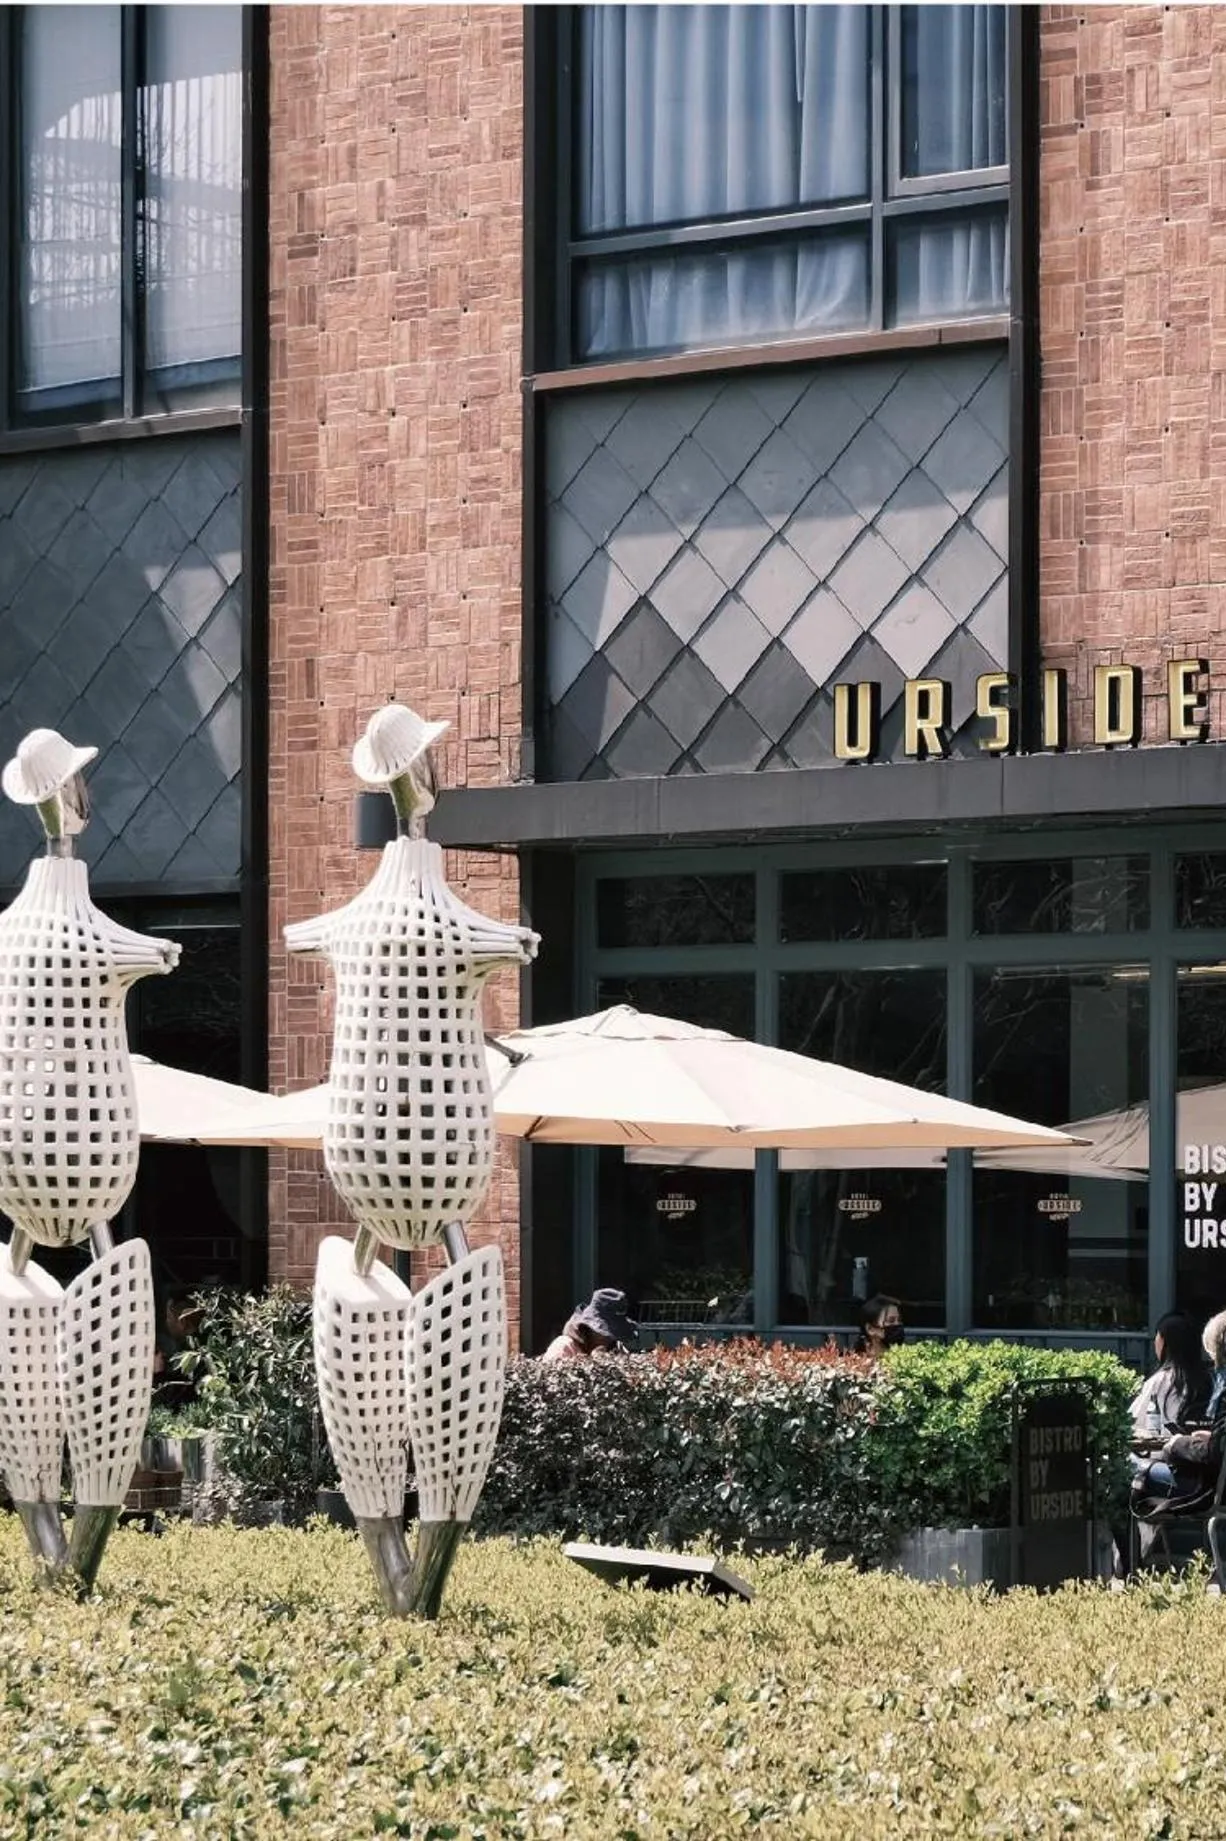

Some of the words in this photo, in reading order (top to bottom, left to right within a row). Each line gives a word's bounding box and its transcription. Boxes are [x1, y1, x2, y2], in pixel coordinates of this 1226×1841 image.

[834, 658, 1208, 761] URSIDE
[1184, 1182, 1217, 1213] BY
[1029, 1425, 1082, 1455] BISTRO
[1029, 1459, 1049, 1489] BY
[1030, 1490, 1083, 1520] URSIDE
